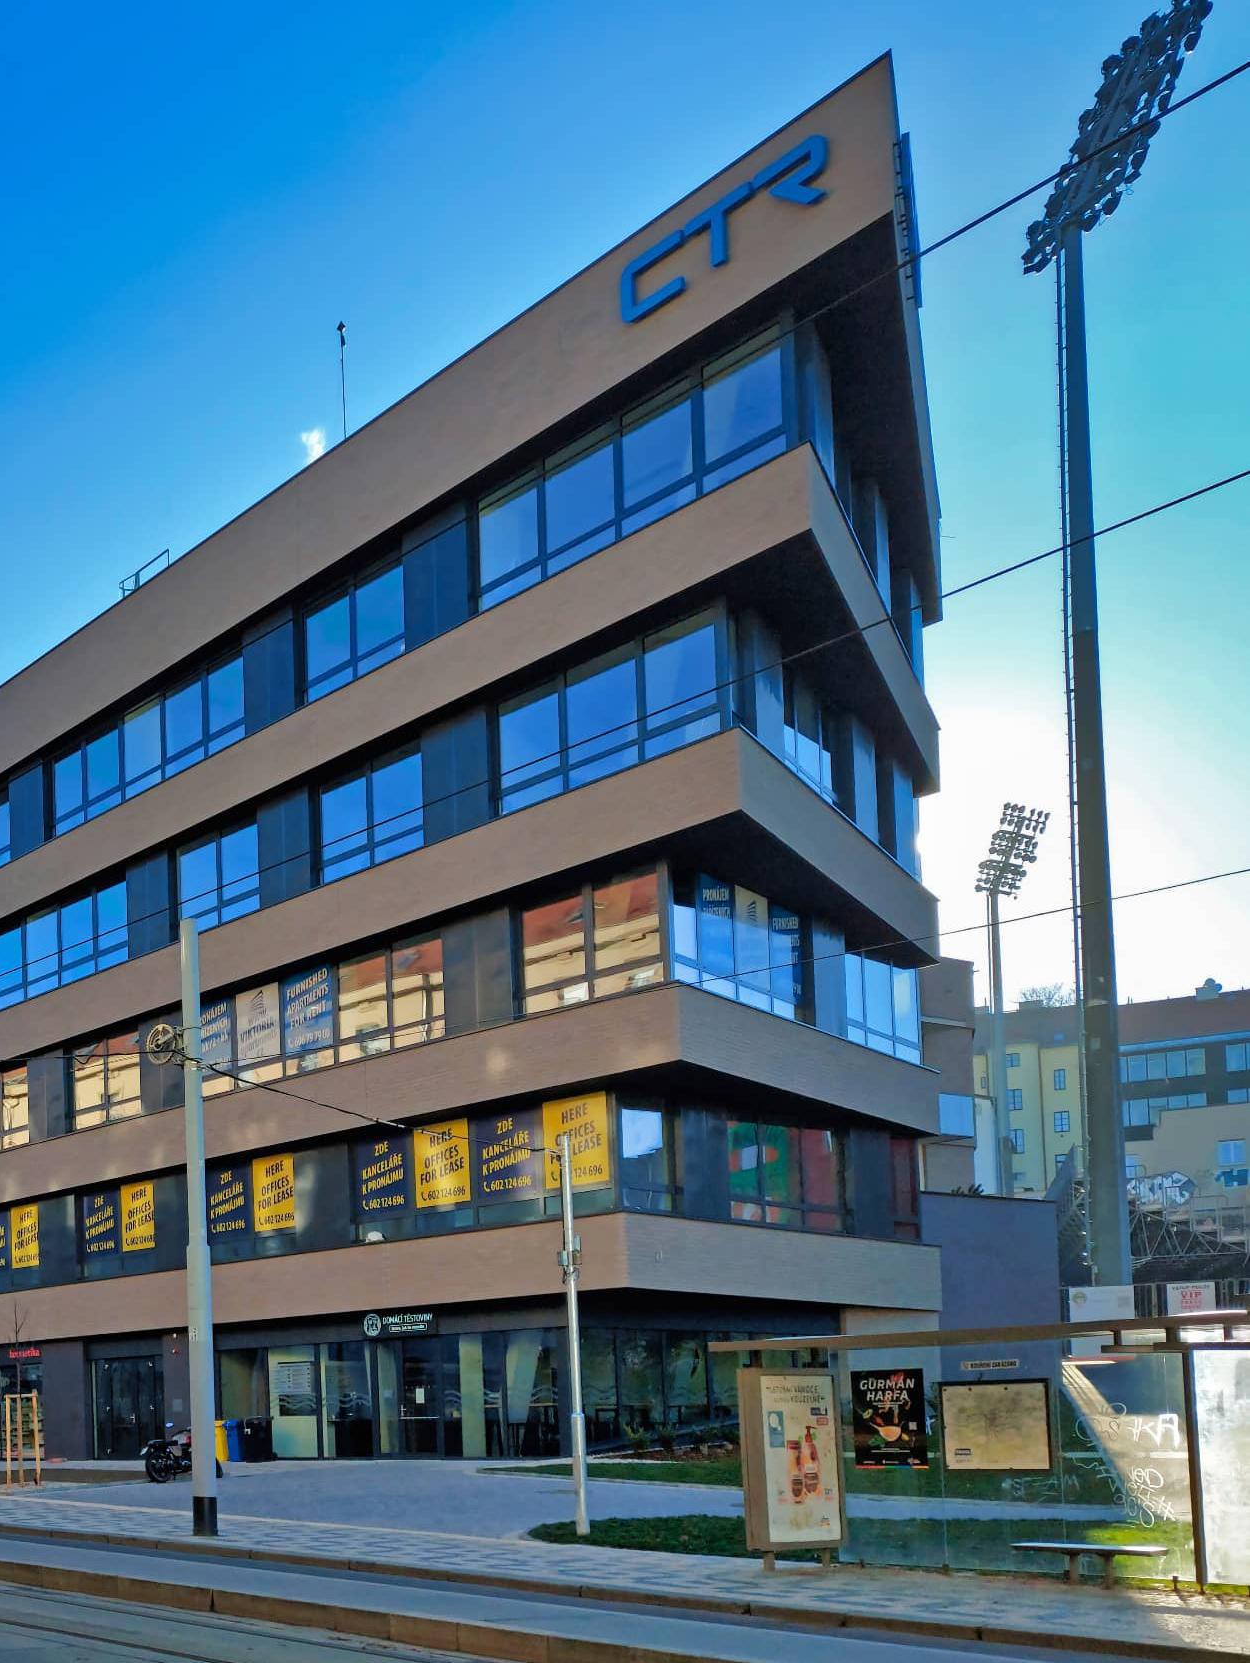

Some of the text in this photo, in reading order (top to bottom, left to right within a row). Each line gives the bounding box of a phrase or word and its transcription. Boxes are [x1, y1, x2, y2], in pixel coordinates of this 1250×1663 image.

[620, 133, 829, 324] CTR
[286, 967, 328, 1000] FURNISHED
[286, 983, 329, 1018] APARTMENTS
[201, 1002, 227, 1024] ONÁJEM
[561, 1103, 588, 1124] HERE
[497, 1118, 513, 1134] ZDE
[555, 1120, 595, 1147] OFICES
[430, 1128, 453, 1148] HERE
[482, 1131, 529, 1160] KANCELÁŘE
[573, 1133, 602, 1156] LEASE
[375, 1141, 389, 1157] ZDE
[424, 1144, 459, 1169] OFFICES
[265, 1160, 284, 1178] HERE
[362, 1152, 403, 1180] KANCELÁŘE
[420, 1157, 465, 1186] FOR LEASE
[482, 1149, 530, 1176] K PRONÁJMU
[588, 1164, 603, 1176] 696
[220, 1170, 232, 1185] ZDE
[261, 1175, 289, 1196] OFFICES
[362, 1167, 404, 1195] K PRONÁJMU
[491, 1175, 532, 1191] 602 124 696
[131, 1186, 147, 1203] HERE
[258, 1185, 294, 1211] FOR LEASE
[369, 1195, 405, 1209] 602 124 696
[428, 1185, 466, 1200] 602 124 696
[127, 1200, 152, 1220] OFFICES
[1181, 1290, 1202, 1298] VIP
[382, 1312, 433, 1325] DOMÁCÍ TĚSTOVINY
[867, 1390, 909, 1402] HARFA
